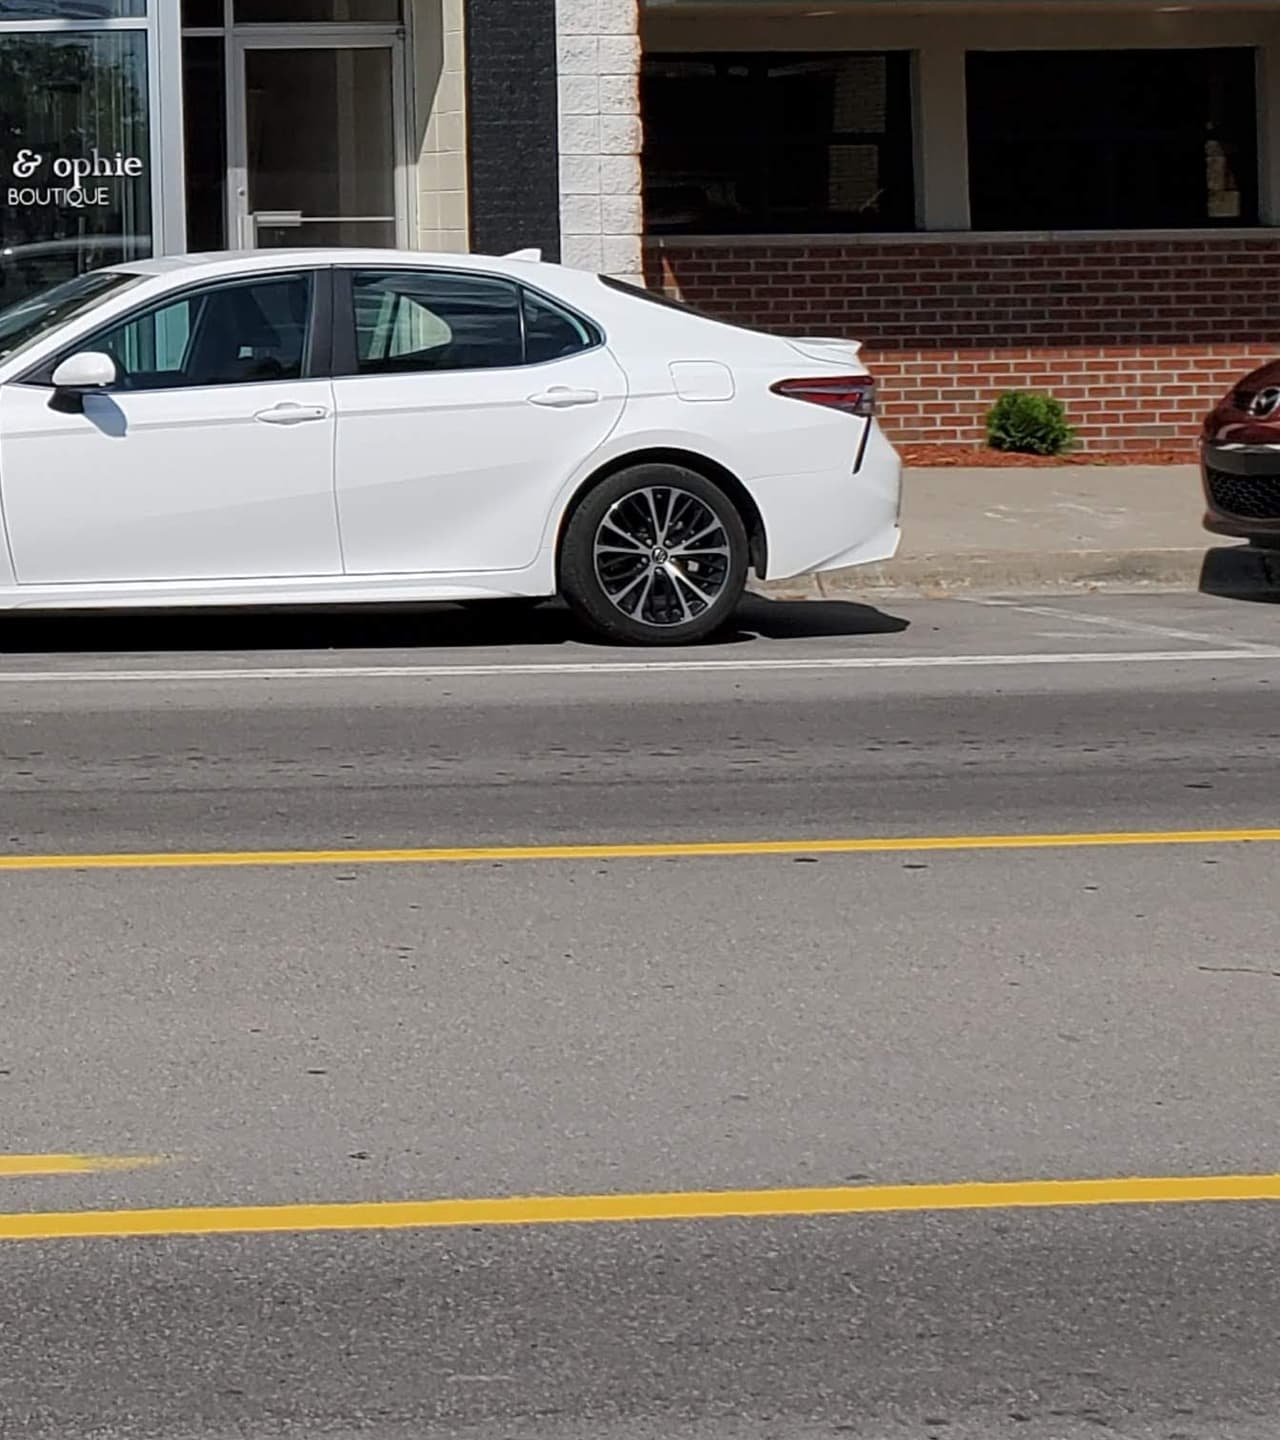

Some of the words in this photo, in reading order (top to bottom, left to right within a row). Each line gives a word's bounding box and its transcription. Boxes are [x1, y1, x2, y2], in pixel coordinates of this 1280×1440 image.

[12, 149, 42, 178] &
[53, 148, 143, 189] ophie
[7, 187, 110, 208] BOUTIQUE
